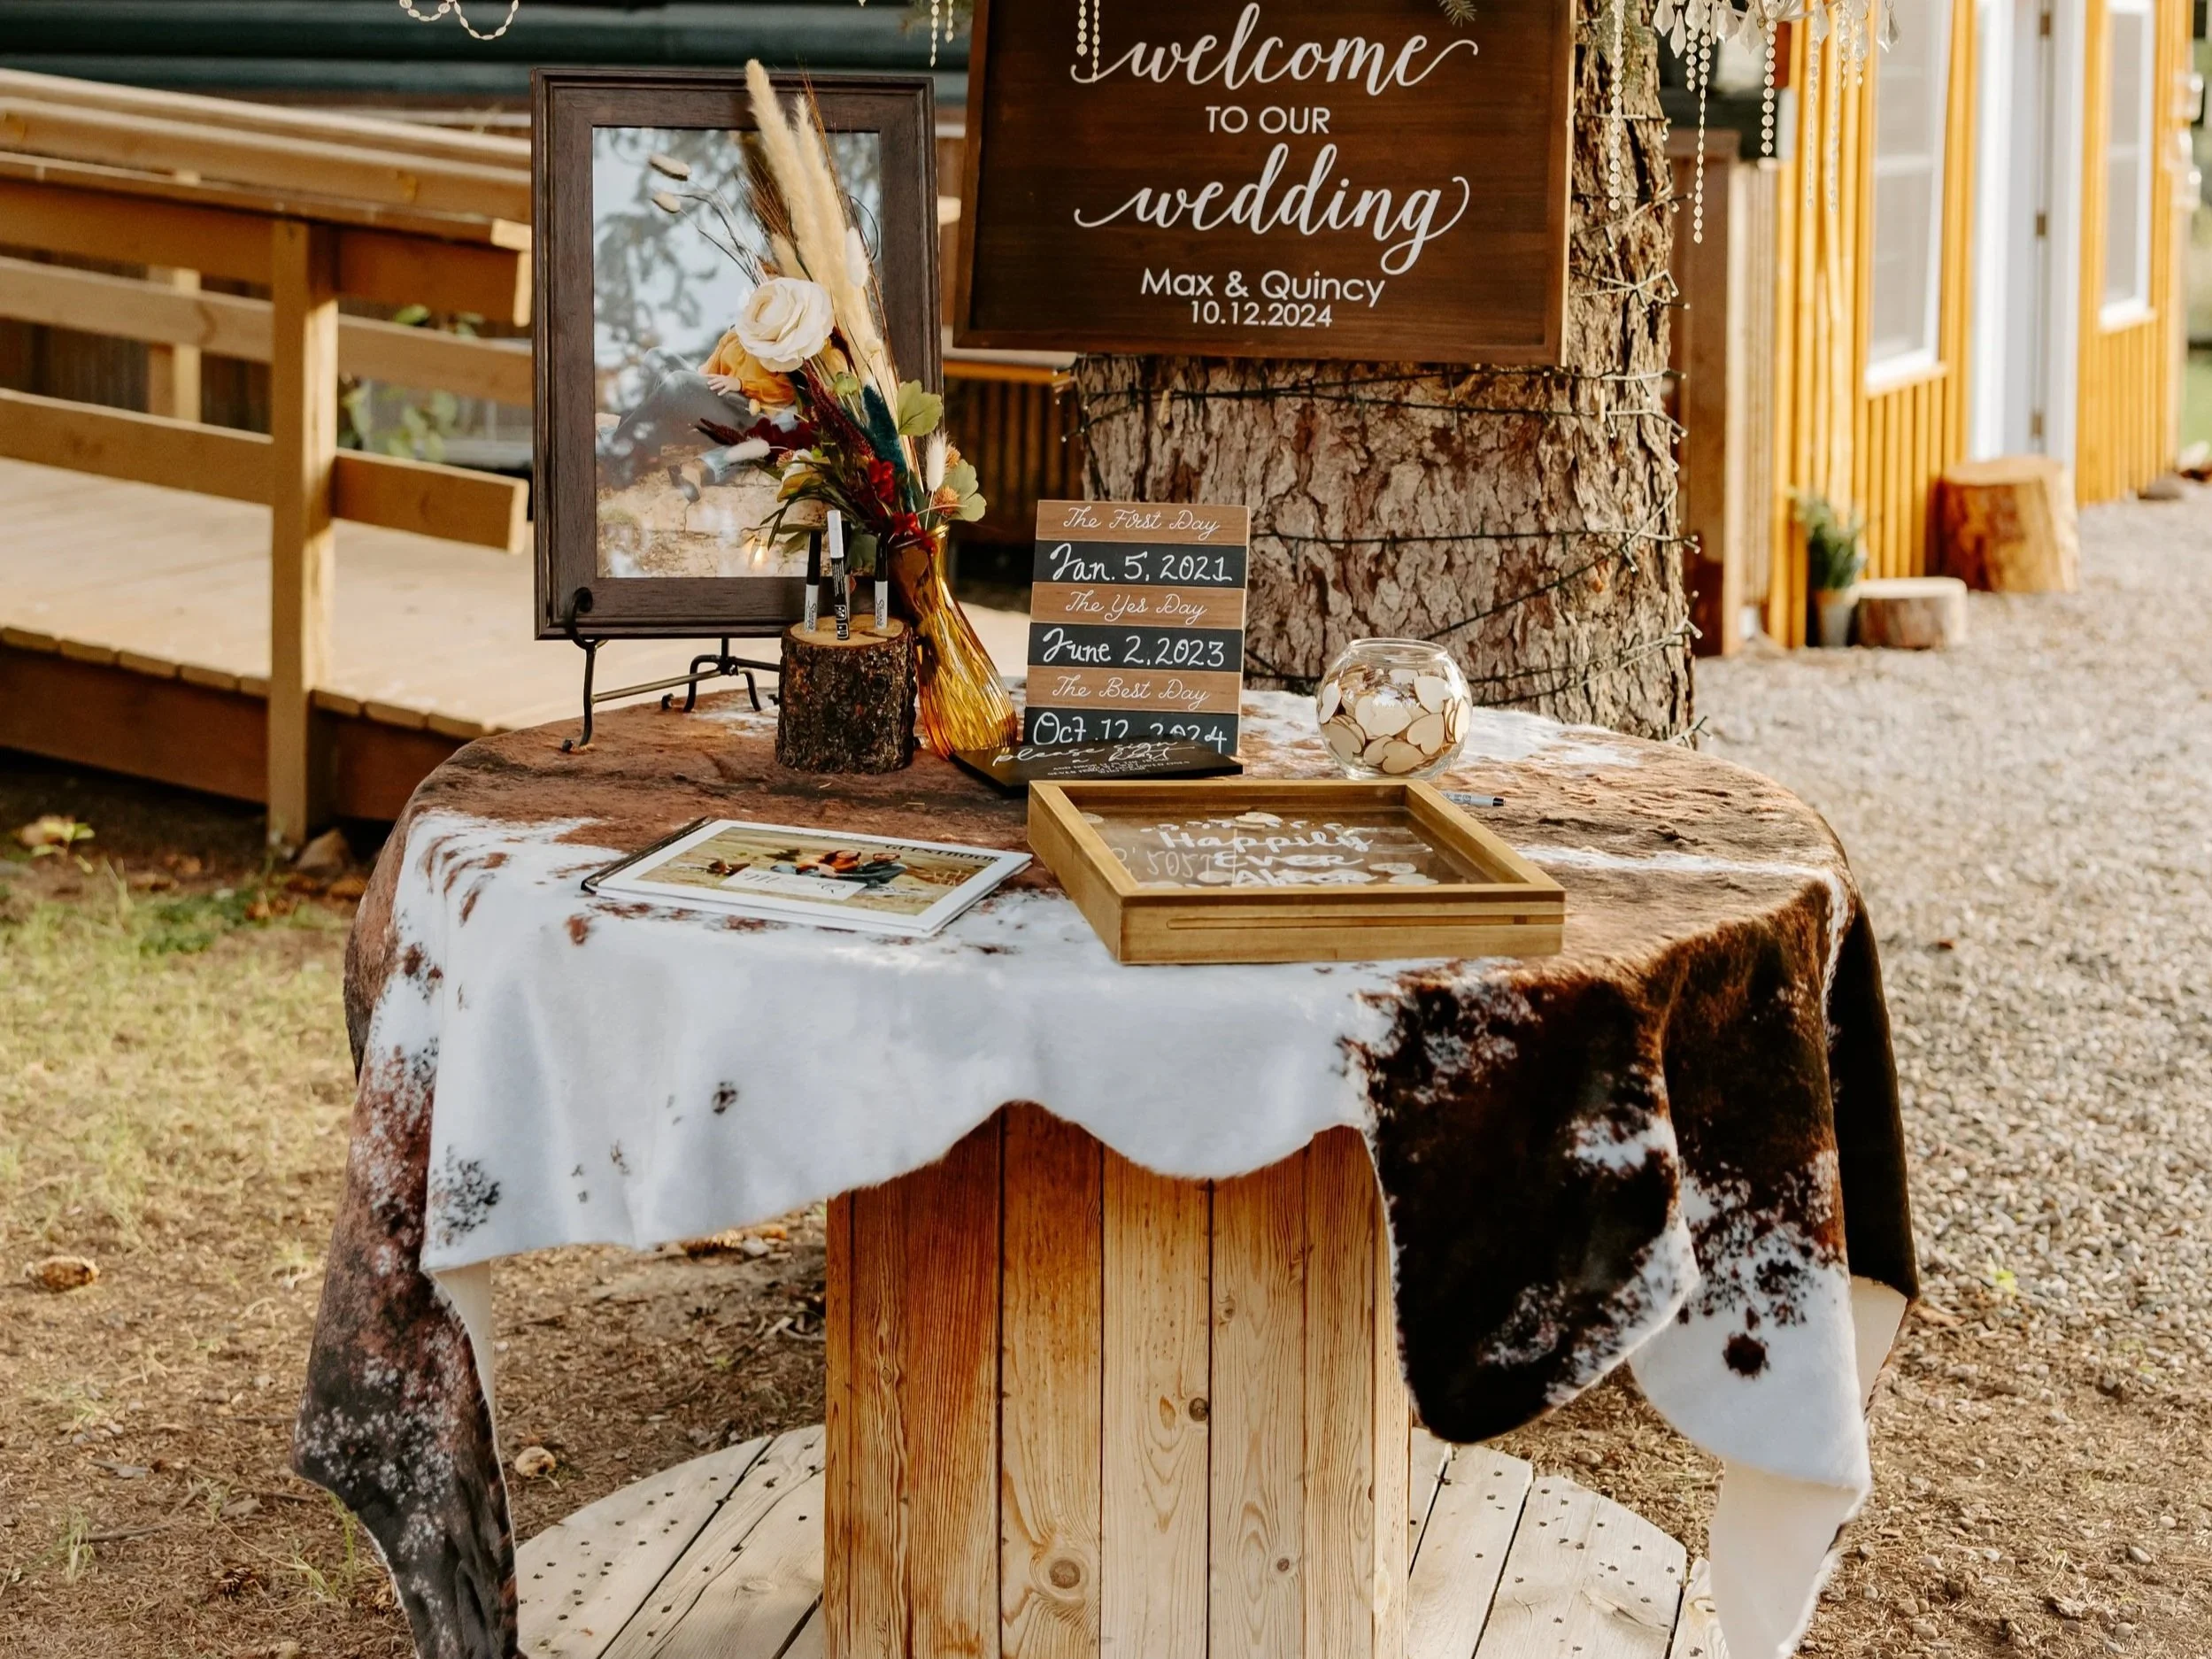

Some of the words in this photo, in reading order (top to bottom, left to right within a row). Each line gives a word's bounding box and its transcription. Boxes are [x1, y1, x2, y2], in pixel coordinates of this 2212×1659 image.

[1071, 3, 1478, 95] welcome
[1205, 105, 1248, 134] TO
[1259, 106, 1331, 135] OUR
[1074, 143, 1469, 274] wedding
[1140, 268, 1214, 297] Max
[1225, 271, 1249, 298] &
[1260, 270, 1386, 307] Quincy
[1191, 300, 1333, 327] 10.12.2024
[1063, 506, 1102, 530] The
[1108, 509, 1161, 530] First
[1169, 510, 1220, 541] Day
[1050, 543, 1115, 582] Jan.
[1123, 551, 1150, 582] 5,
[1159, 554, 1233, 583] 2021
[1066, 590, 1106, 613] The
[1104, 593, 1149, 621] Yes
[1156, 594, 1207, 625] Day
[1043, 627, 1112, 663] June
[1052, 675, 1091, 698] The
[1098, 676, 1152, 700] Best
[1159, 678, 1211, 710] Day
[1159, 831, 1373, 853] Happily
[1214, 851, 1364, 868] Ever
